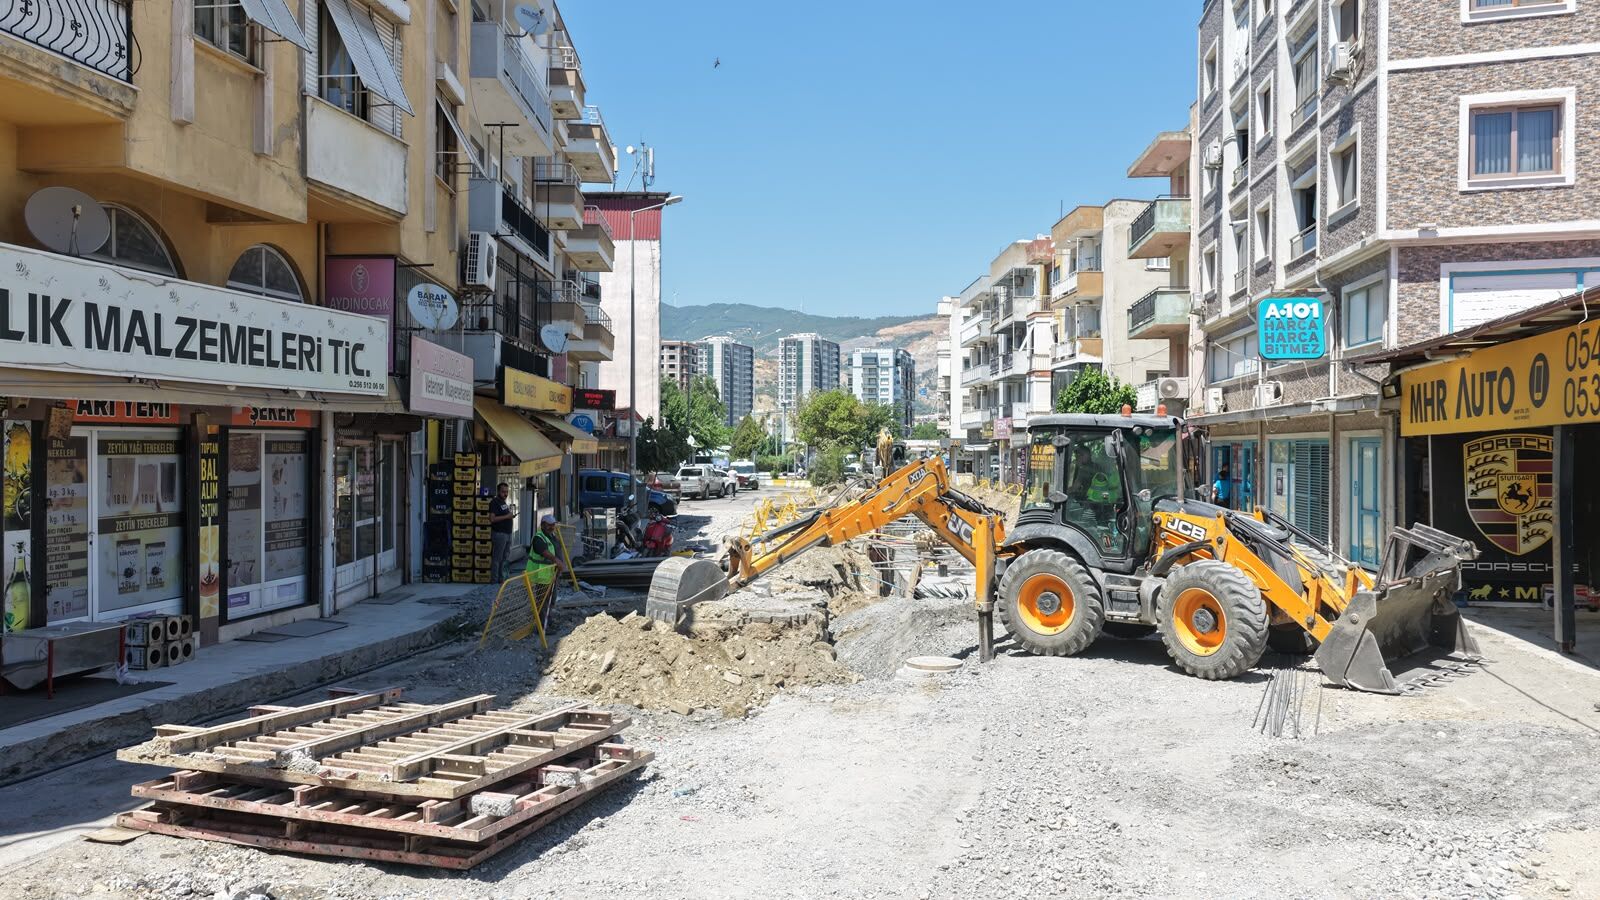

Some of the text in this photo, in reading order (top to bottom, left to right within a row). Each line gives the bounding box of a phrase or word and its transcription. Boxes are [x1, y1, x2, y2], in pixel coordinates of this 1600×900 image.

[330, 296, 390, 310] AYDINOCAK
[417, 291, 447, 301] BARAN
[1264, 320, 1319, 331] HARCA
[85, 301, 322, 373] MALZEMELERİ
[1264, 331, 1319, 343] HARCA
[1409, 366, 1516, 424] MHR AUTO
[107, 440, 175, 454] ZEYTİN YAĞI TENEKELERİ
[201, 442, 219, 454] TOPTAN
[1467, 437, 1553, 456] PORSCH
[201, 458, 218, 481] BAL
[201, 482, 218, 500] ALIM
[115, 516, 169, 531] ZEYTİN TENEKELERİ
[1166, 519, 1206, 541] JCB
